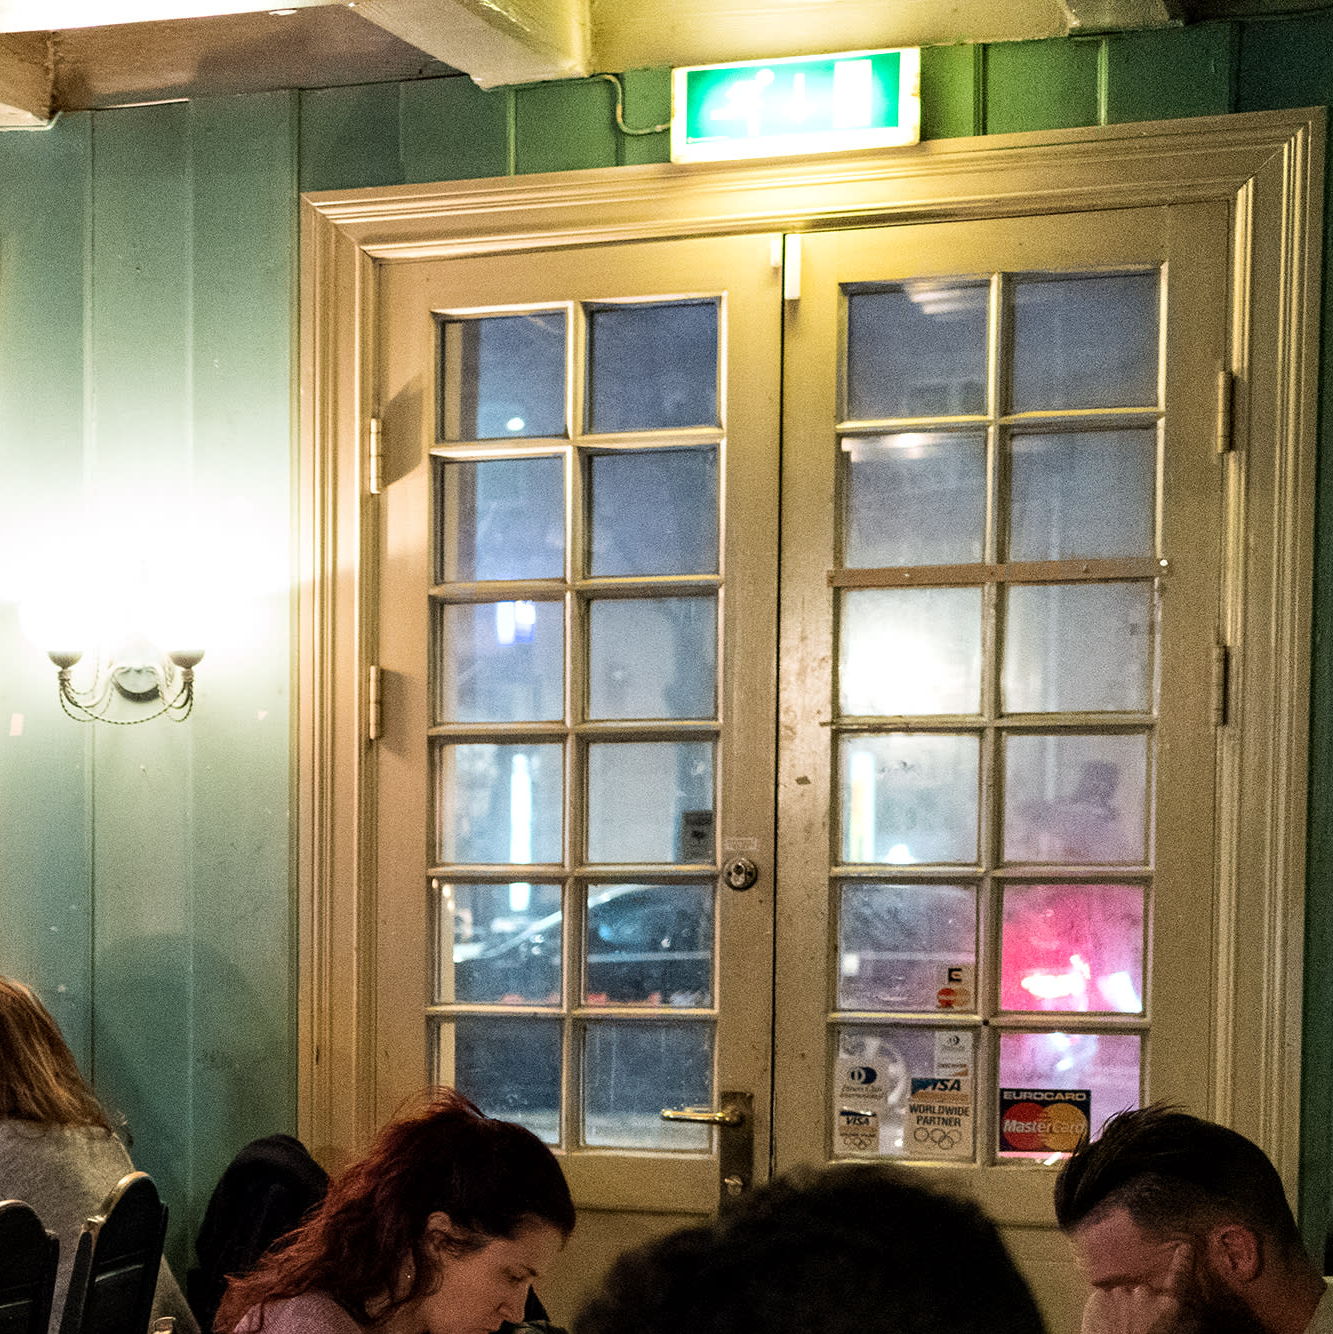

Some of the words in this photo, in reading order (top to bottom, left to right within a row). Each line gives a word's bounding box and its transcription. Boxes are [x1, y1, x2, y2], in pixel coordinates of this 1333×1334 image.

[1003, 1091, 1087, 1101] EUROCARD
[909, 1103, 970, 1117] WORLDWIDE
[846, 1117, 870, 1126] VISA
[916, 1115, 962, 1127] PARTNER
[1003, 1119, 1088, 1134] MasterCard
